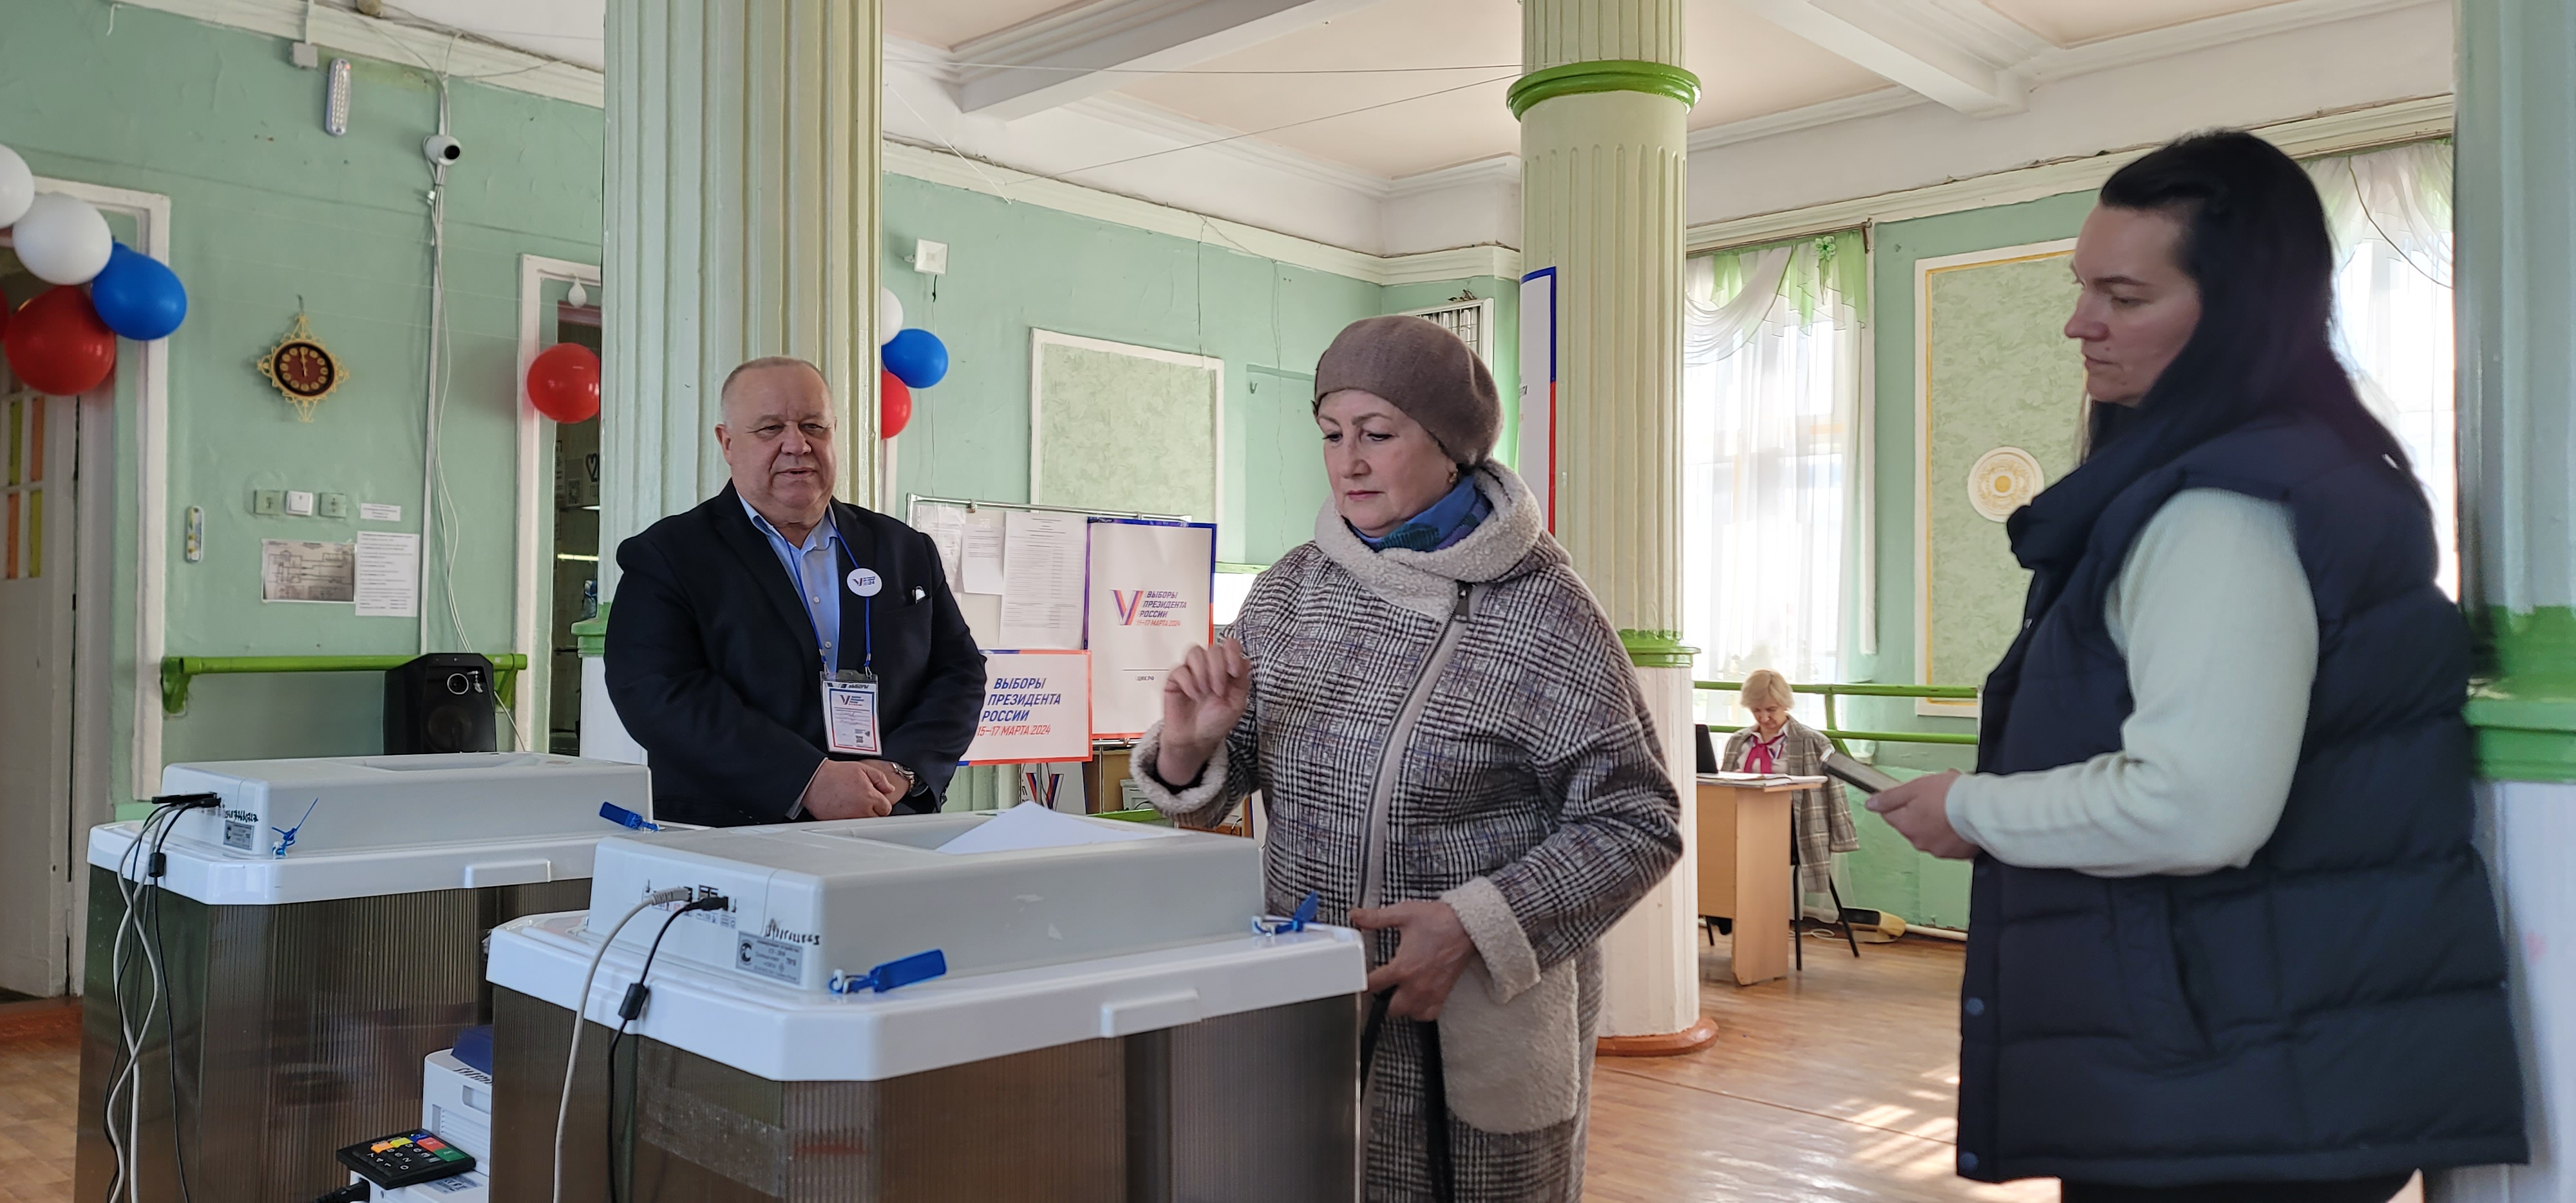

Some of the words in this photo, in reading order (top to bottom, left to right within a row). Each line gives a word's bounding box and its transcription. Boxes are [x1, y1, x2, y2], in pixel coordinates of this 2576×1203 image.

[1146, 591, 1179, 599] ВЫБОРЫ
[1142, 600, 1187, 609] ПРЕЗИДЕНТА
[1139, 610, 1168, 618] РОССИИ
[994, 677, 1046, 690] ВЫБОРЫ
[987, 693, 1061, 707] ПРЕЗИДЕНТА
[981, 710, 1030, 722] РОССИИ
[1001, 725, 1030, 735] МАРТА
[1030, 725, 1051, 735] 2024
